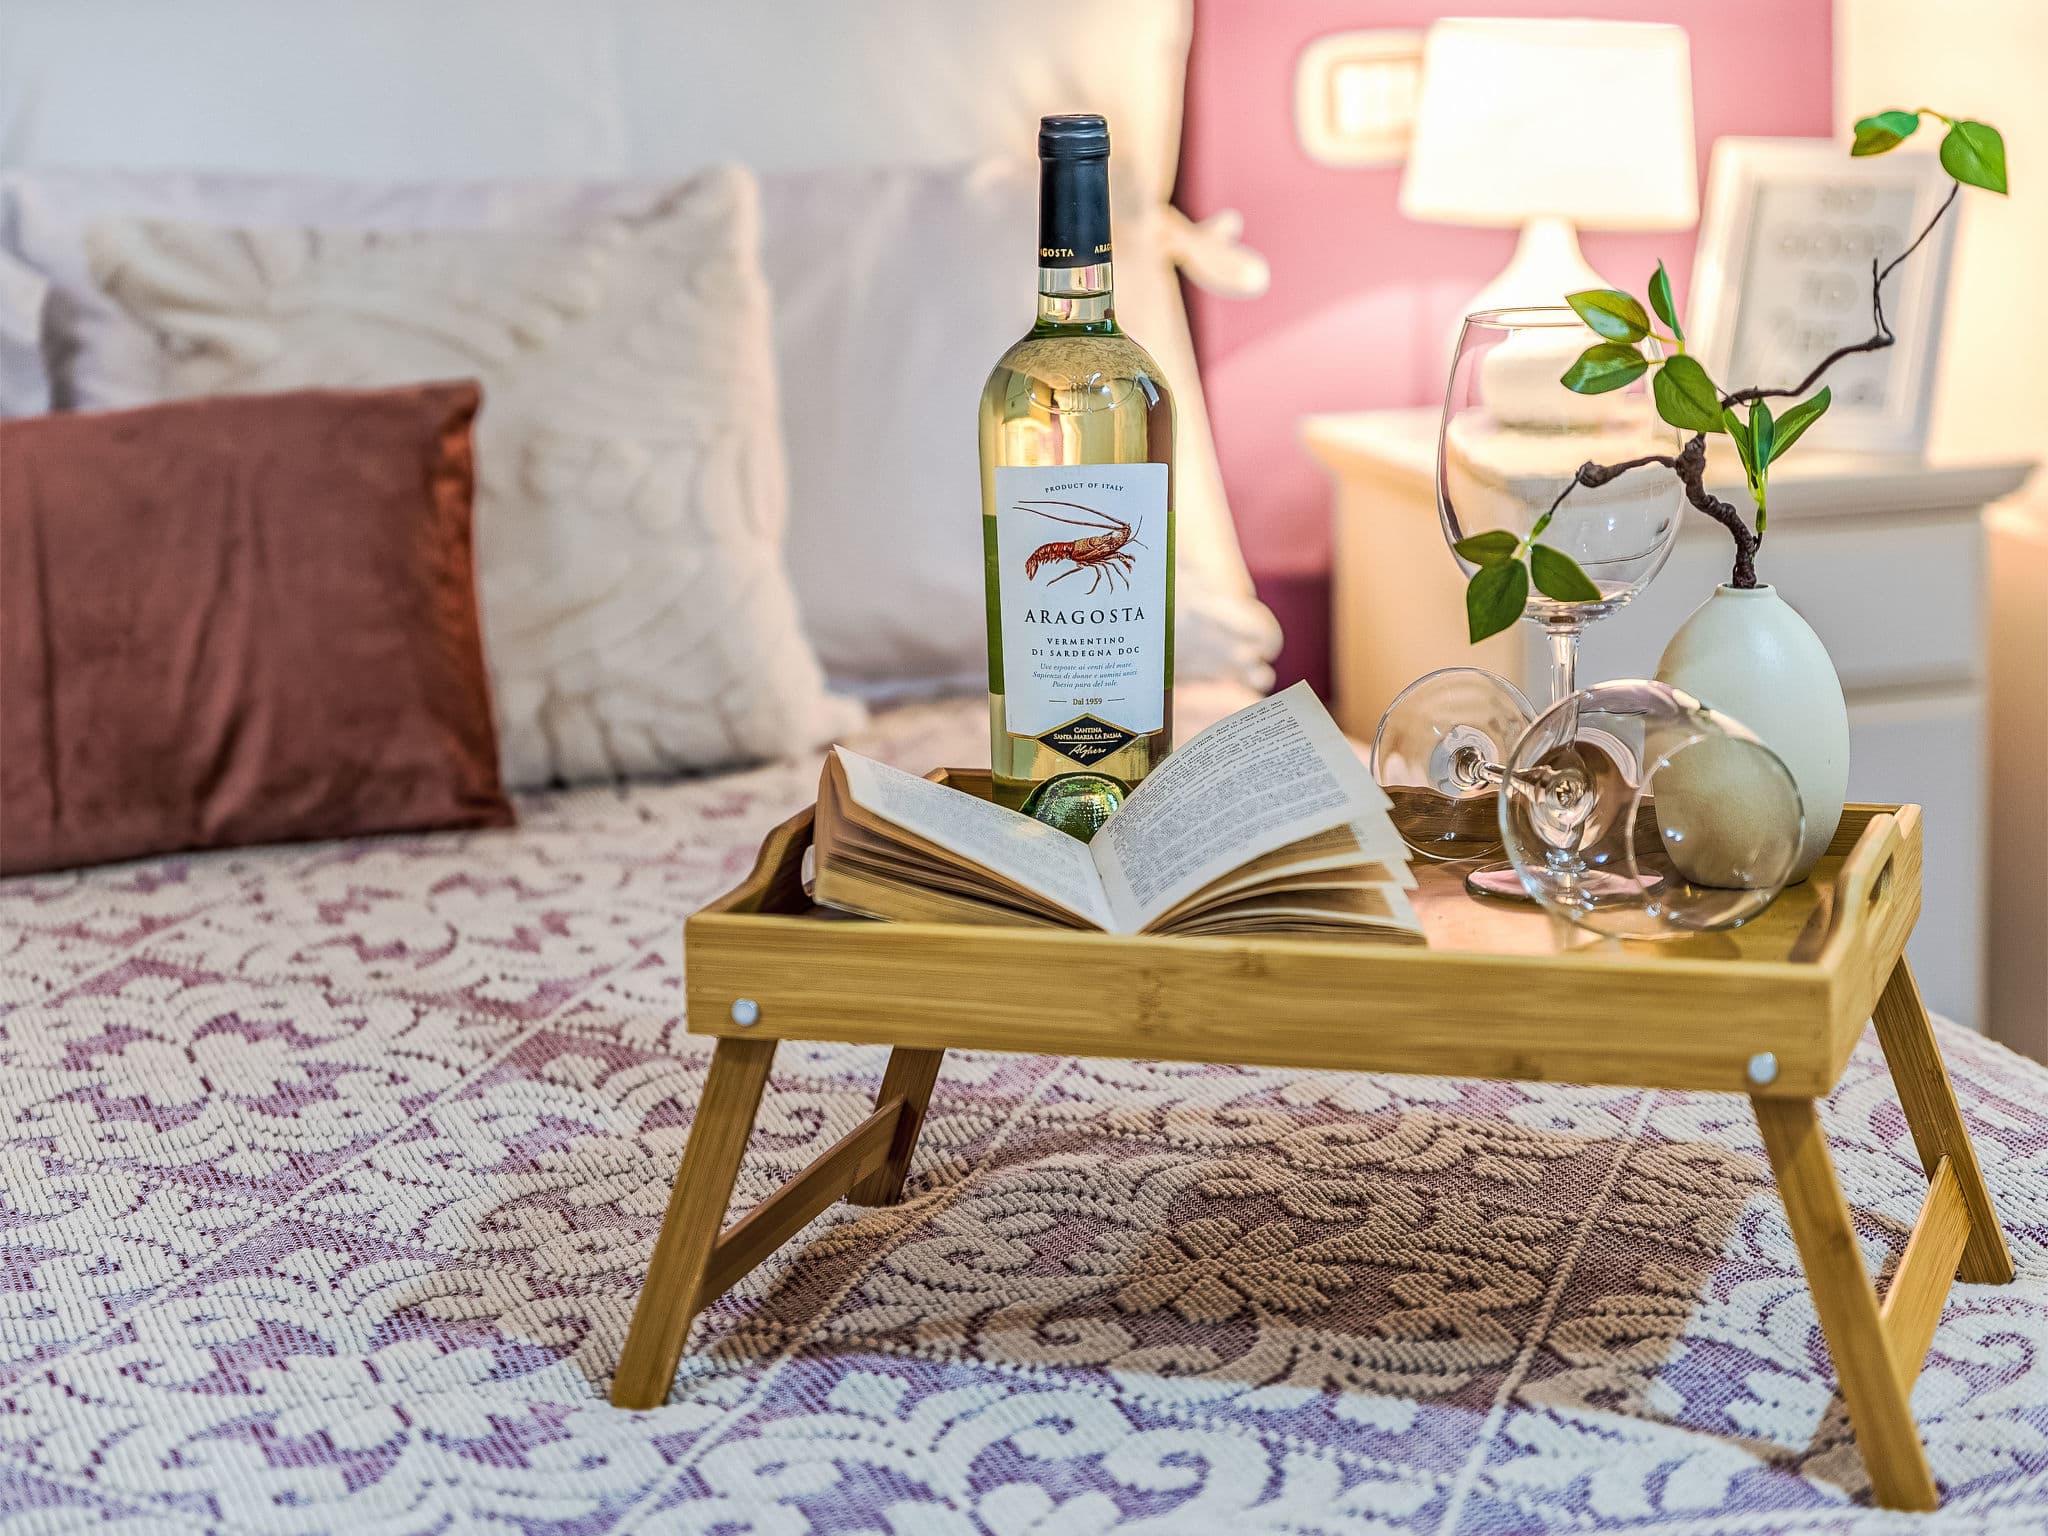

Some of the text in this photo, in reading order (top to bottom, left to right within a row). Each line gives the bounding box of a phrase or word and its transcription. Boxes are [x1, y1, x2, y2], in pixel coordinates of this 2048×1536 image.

[1045, 482, 1084, 493] PRODUCT
[1102, 483, 1124, 491] ITALY
[1024, 606, 1145, 624] ARAGOSTA
[1047, 636, 1125, 646] VERMENTINO
[1050, 649, 1112, 657] SARDEGNA
[1118, 646, 1140, 655] DOC
[1085, 697, 1103, 705] 1959
[1073, 726, 1103, 734] CANTINA
